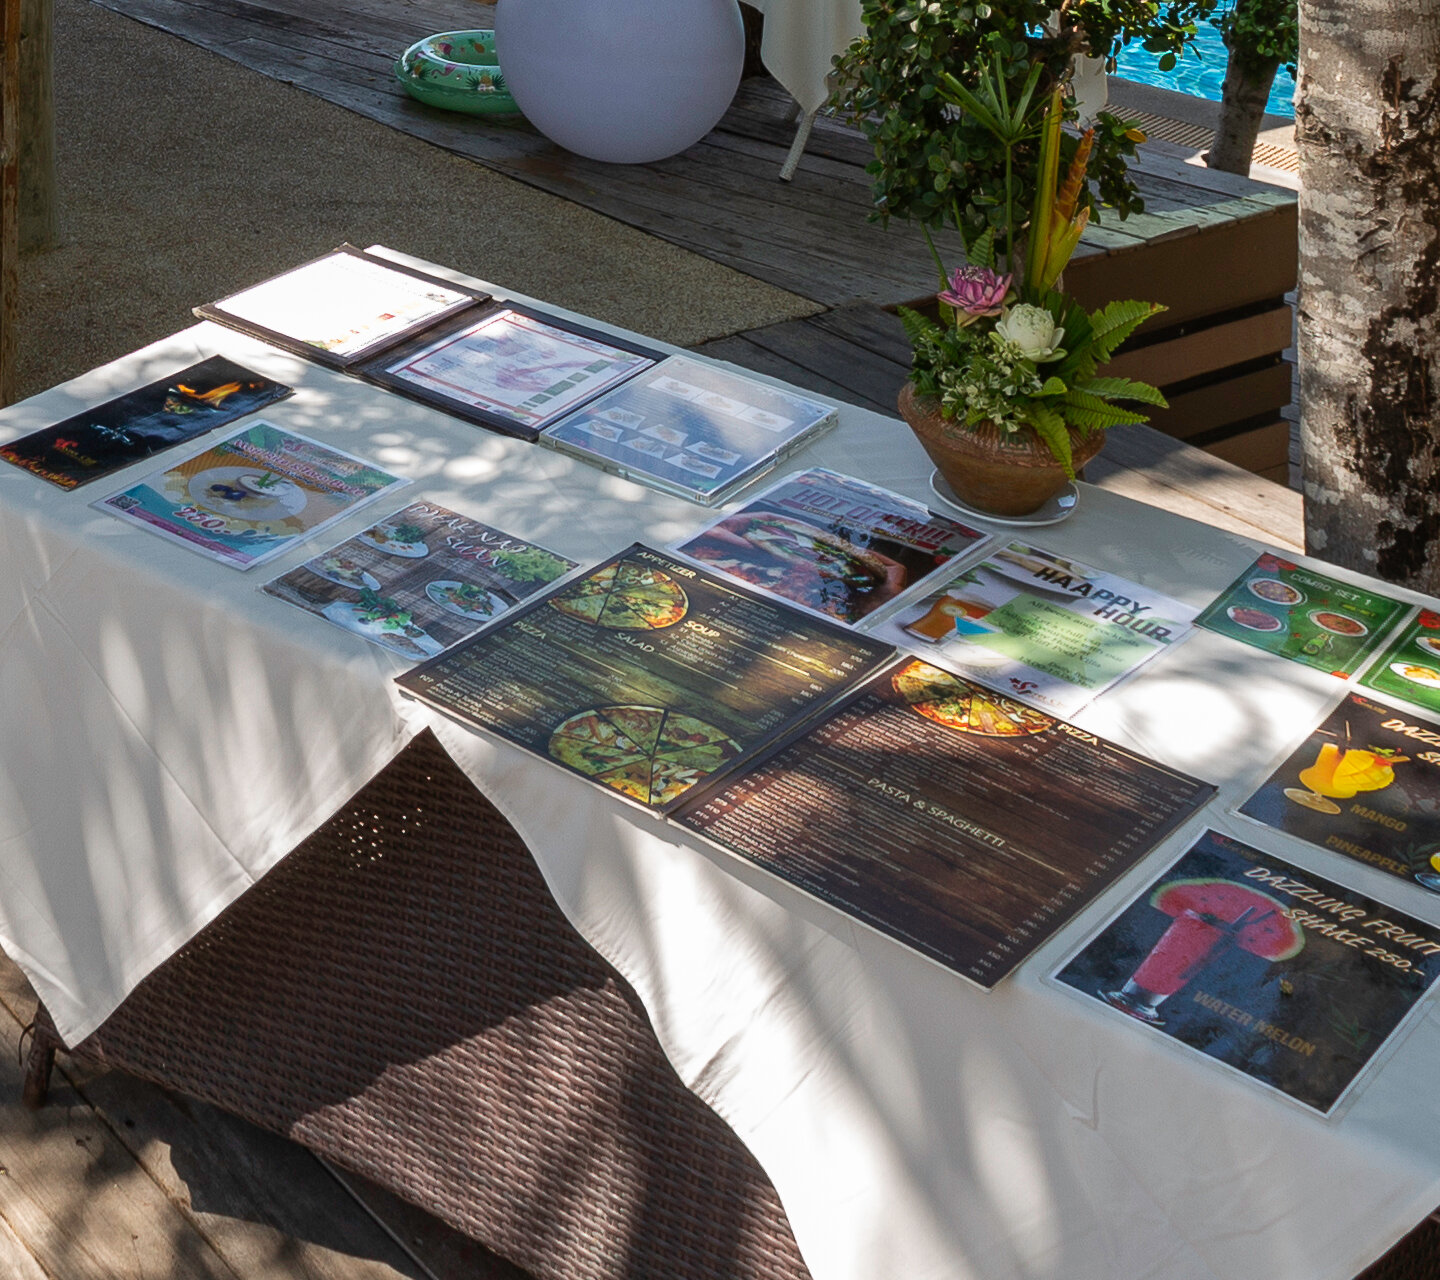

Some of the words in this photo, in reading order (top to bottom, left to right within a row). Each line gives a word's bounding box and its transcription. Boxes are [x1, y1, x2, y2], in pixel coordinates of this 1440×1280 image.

[792, 490, 851, 511] HOT
[173, 506, 231, 534] 250.-
[636, 551, 696, 578] APPETIZER
[1033, 567, 1152, 613] HAAPPY
[1291, 573, 1331, 591] COMBO
[1335, 589, 1361, 601] SET
[513, 621, 546, 640] PIZZA
[683, 620, 720, 638] SOUP
[1042, 606, 1074, 620] beers
[1072, 617, 1095, 628] and
[1093, 606, 1171, 640] HOUR
[615, 632, 654, 653] SALAD
[1058, 724, 1099, 745] PIZZA
[867, 778, 912, 802] PASTA
[913, 800, 927, 810] &
[928, 806, 1005, 848] SPAGHETTI
[1349, 804, 1407, 831] MANGO
[1326, 835, 1409, 874] PINEAPPLE
[1243, 867, 1367, 922] DAZZLING
[1282, 909, 1377, 948] SHAKE
[1365, 947, 1426, 975] 250.-
[1192, 991, 1254, 1025] WATER
[1254, 1022, 1316, 1055] MELON
